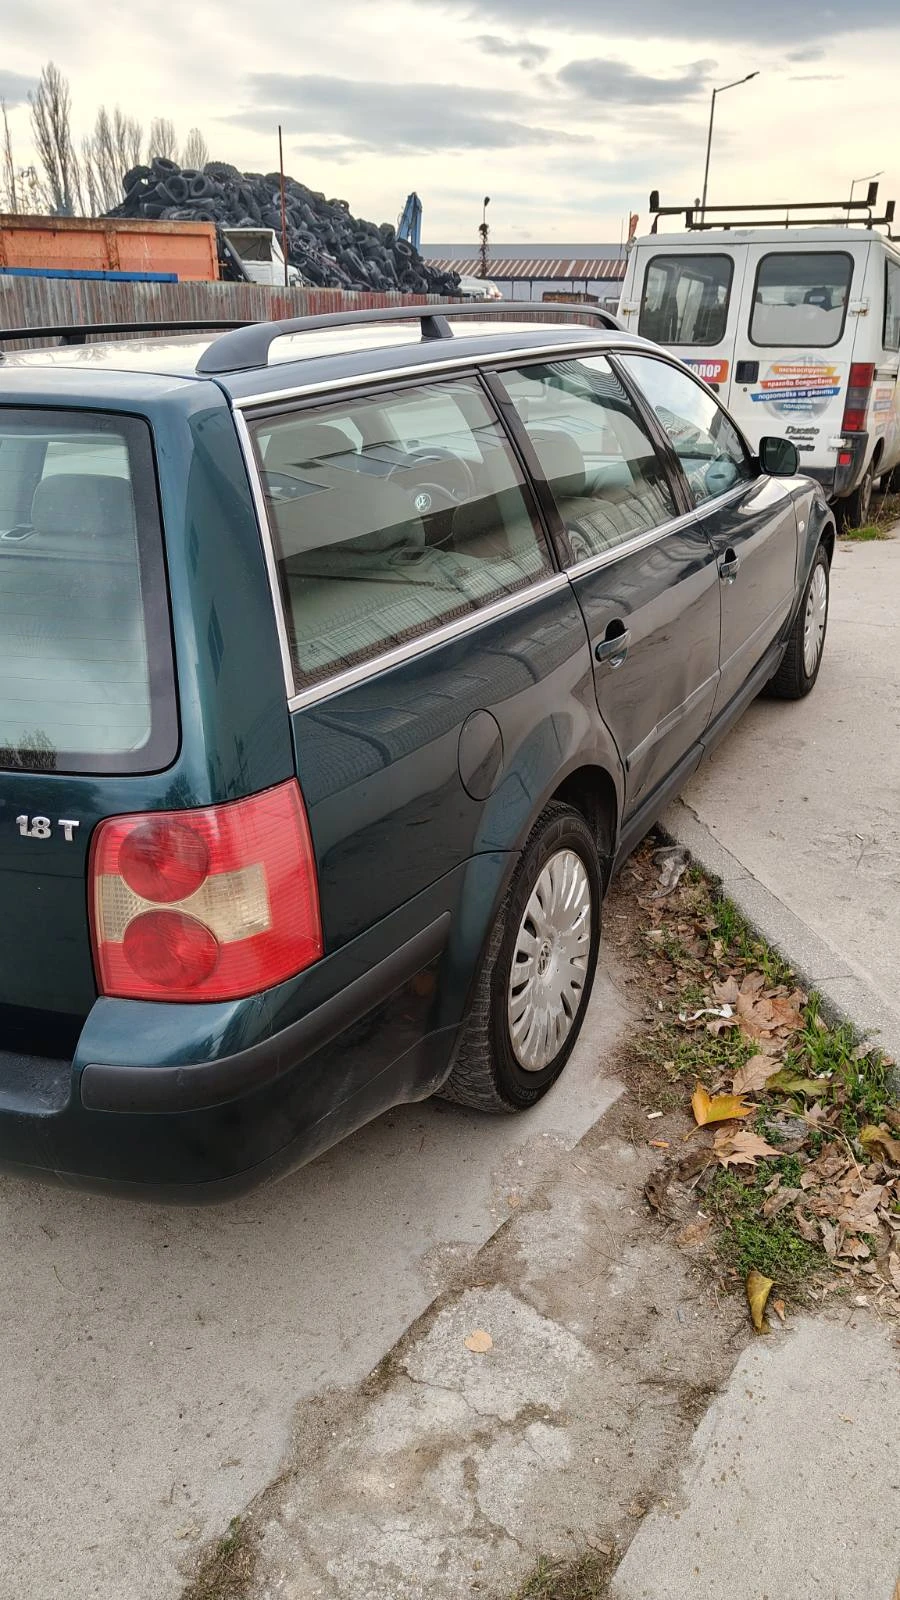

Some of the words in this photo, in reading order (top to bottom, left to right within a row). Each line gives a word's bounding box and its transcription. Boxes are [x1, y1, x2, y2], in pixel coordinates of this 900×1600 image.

[689, 364, 721, 377] ОЛОР
[759, 391, 797, 400] подготовка
[808, 389, 834, 397] джанти
[785, 425, 820, 434] Ducato
[58, 819, 80, 841] T
